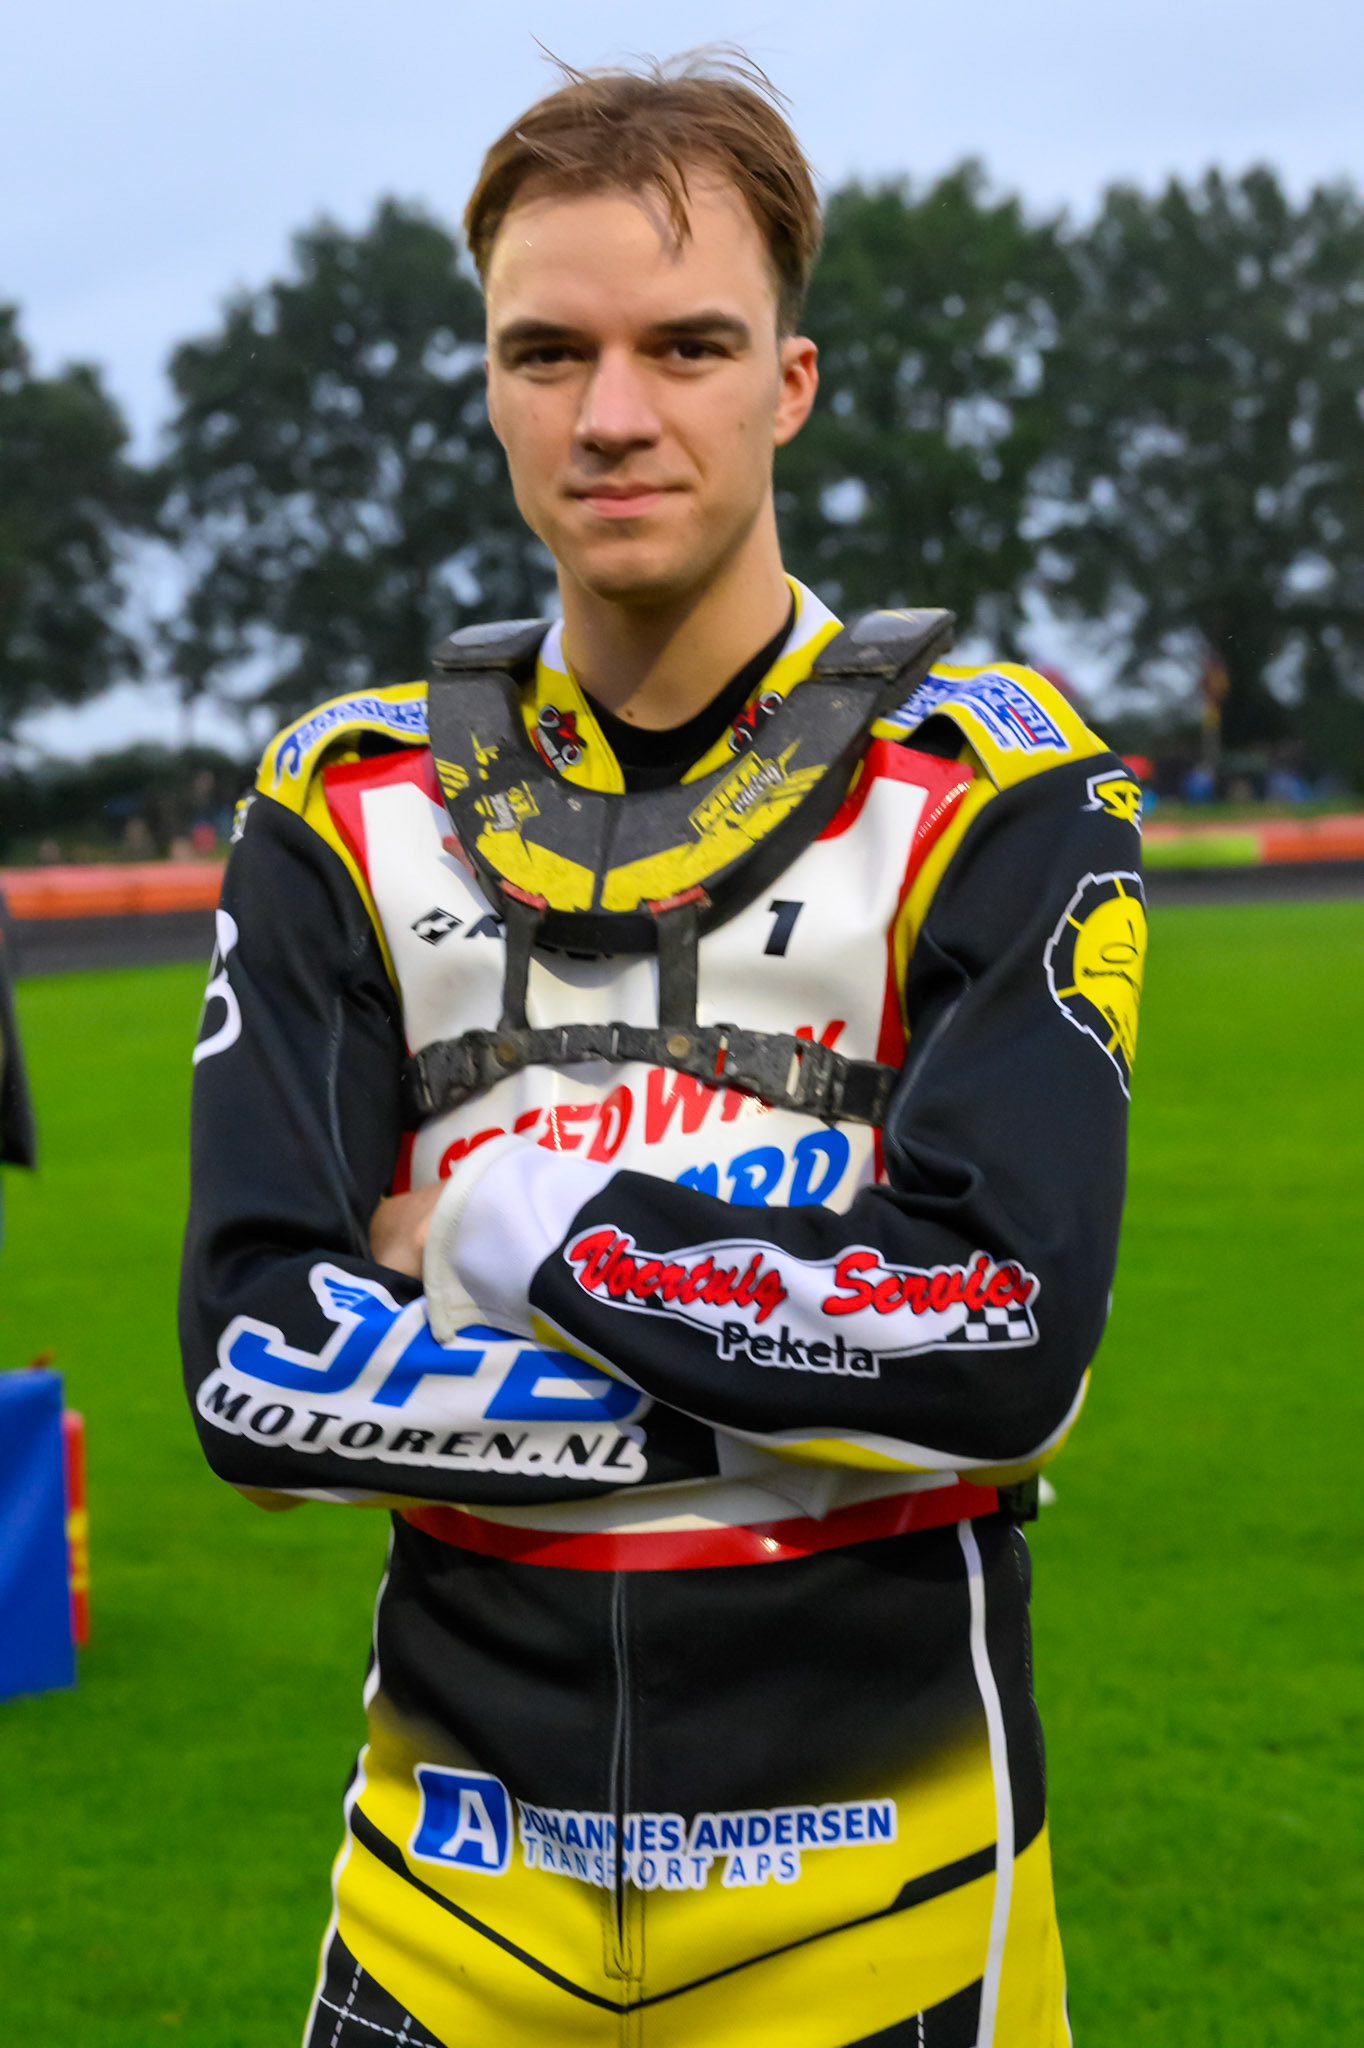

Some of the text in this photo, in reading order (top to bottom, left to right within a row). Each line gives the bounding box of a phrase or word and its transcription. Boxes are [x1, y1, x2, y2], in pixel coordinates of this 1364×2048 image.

[763, 899, 804, 957] 1
[569, 1230, 788, 1324] Voertuig
[722, 1321, 874, 1372] Pekela
[203, 1382, 635, 1469] MOTOREN.NL
[520, 1803, 891, 1851] JOHANNES ANDERSEN
[524, 1836, 796, 1885] TRANSPORT APS
